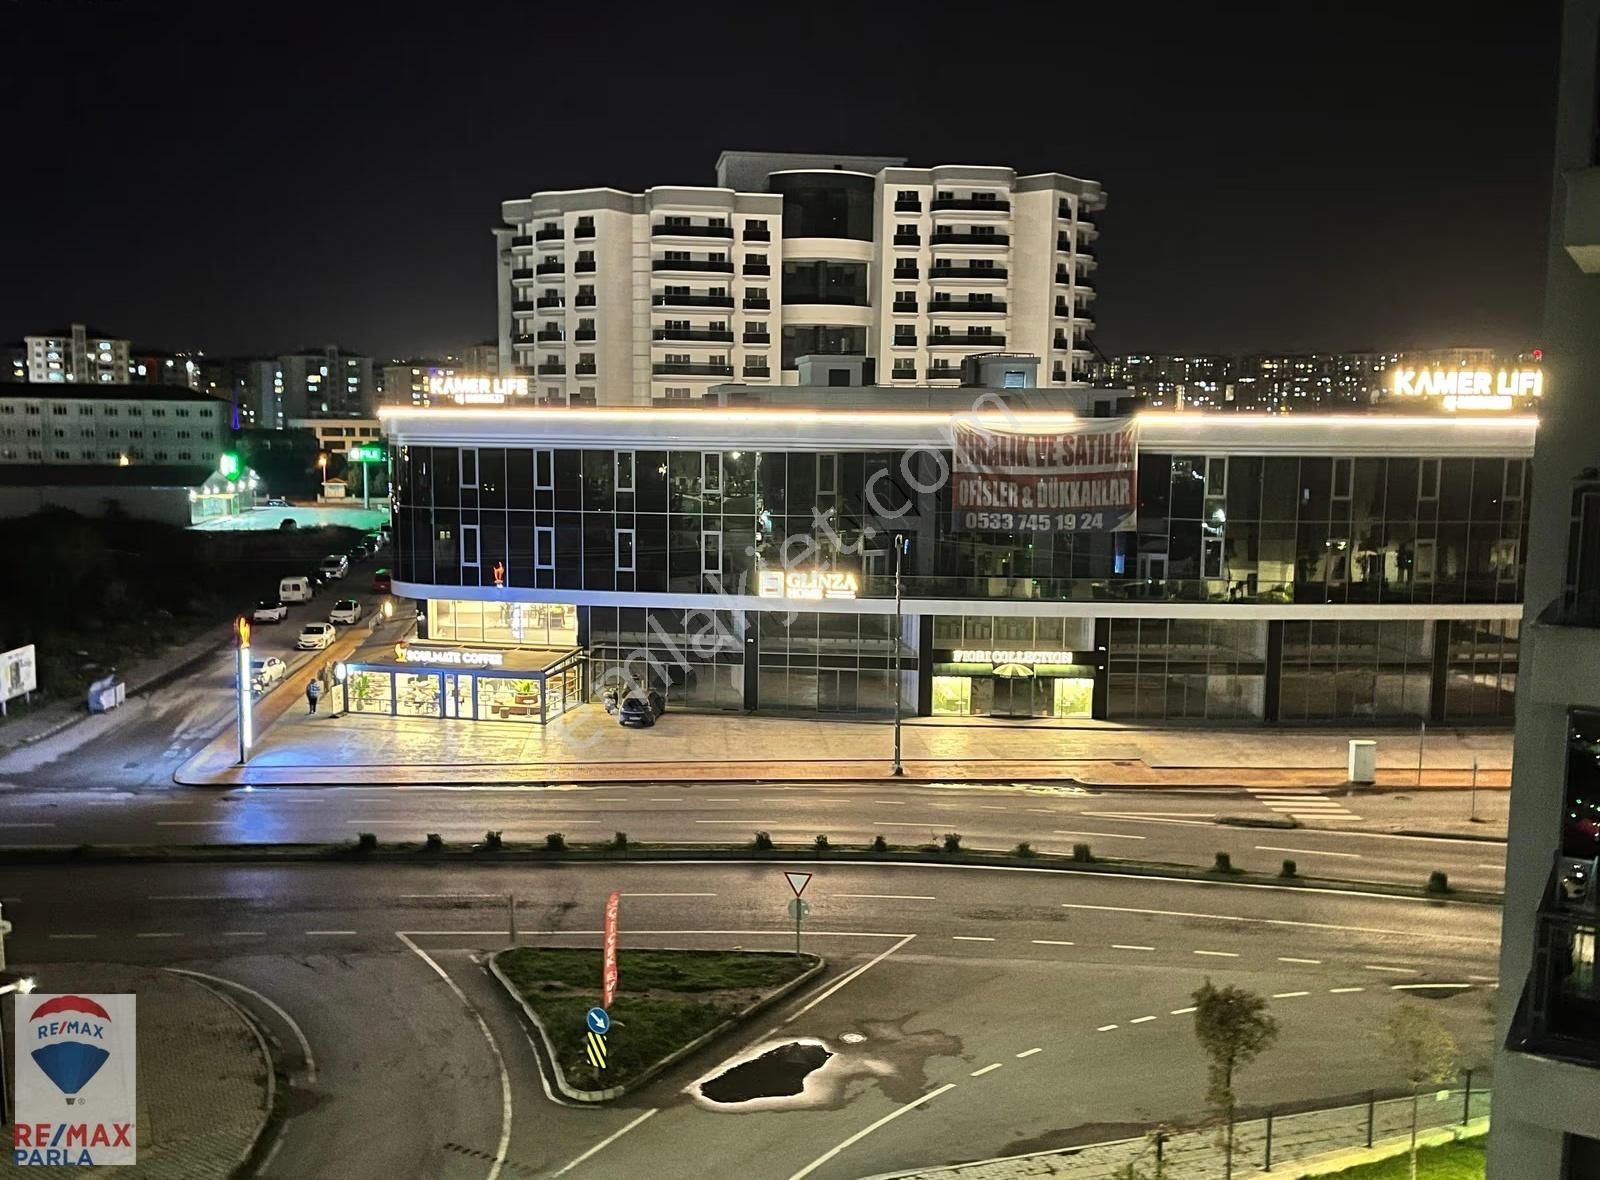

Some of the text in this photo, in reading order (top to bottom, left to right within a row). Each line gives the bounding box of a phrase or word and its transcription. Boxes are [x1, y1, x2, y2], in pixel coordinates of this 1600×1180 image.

[430, 377, 528, 396] KAMER LIFE
[1393, 369, 1492, 396] KAMER
[1034, 434, 1058, 467] VE
[1062, 430, 1133, 466] SATILIK
[959, 476, 1130, 508] OFİSLER & DÜKKANLAR
[966, 512, 1104, 531] 0533 745 19 24
[406, 650, 503, 665] SOULMATE COFFEE
[992, 651, 1073, 664] COLLECTION
